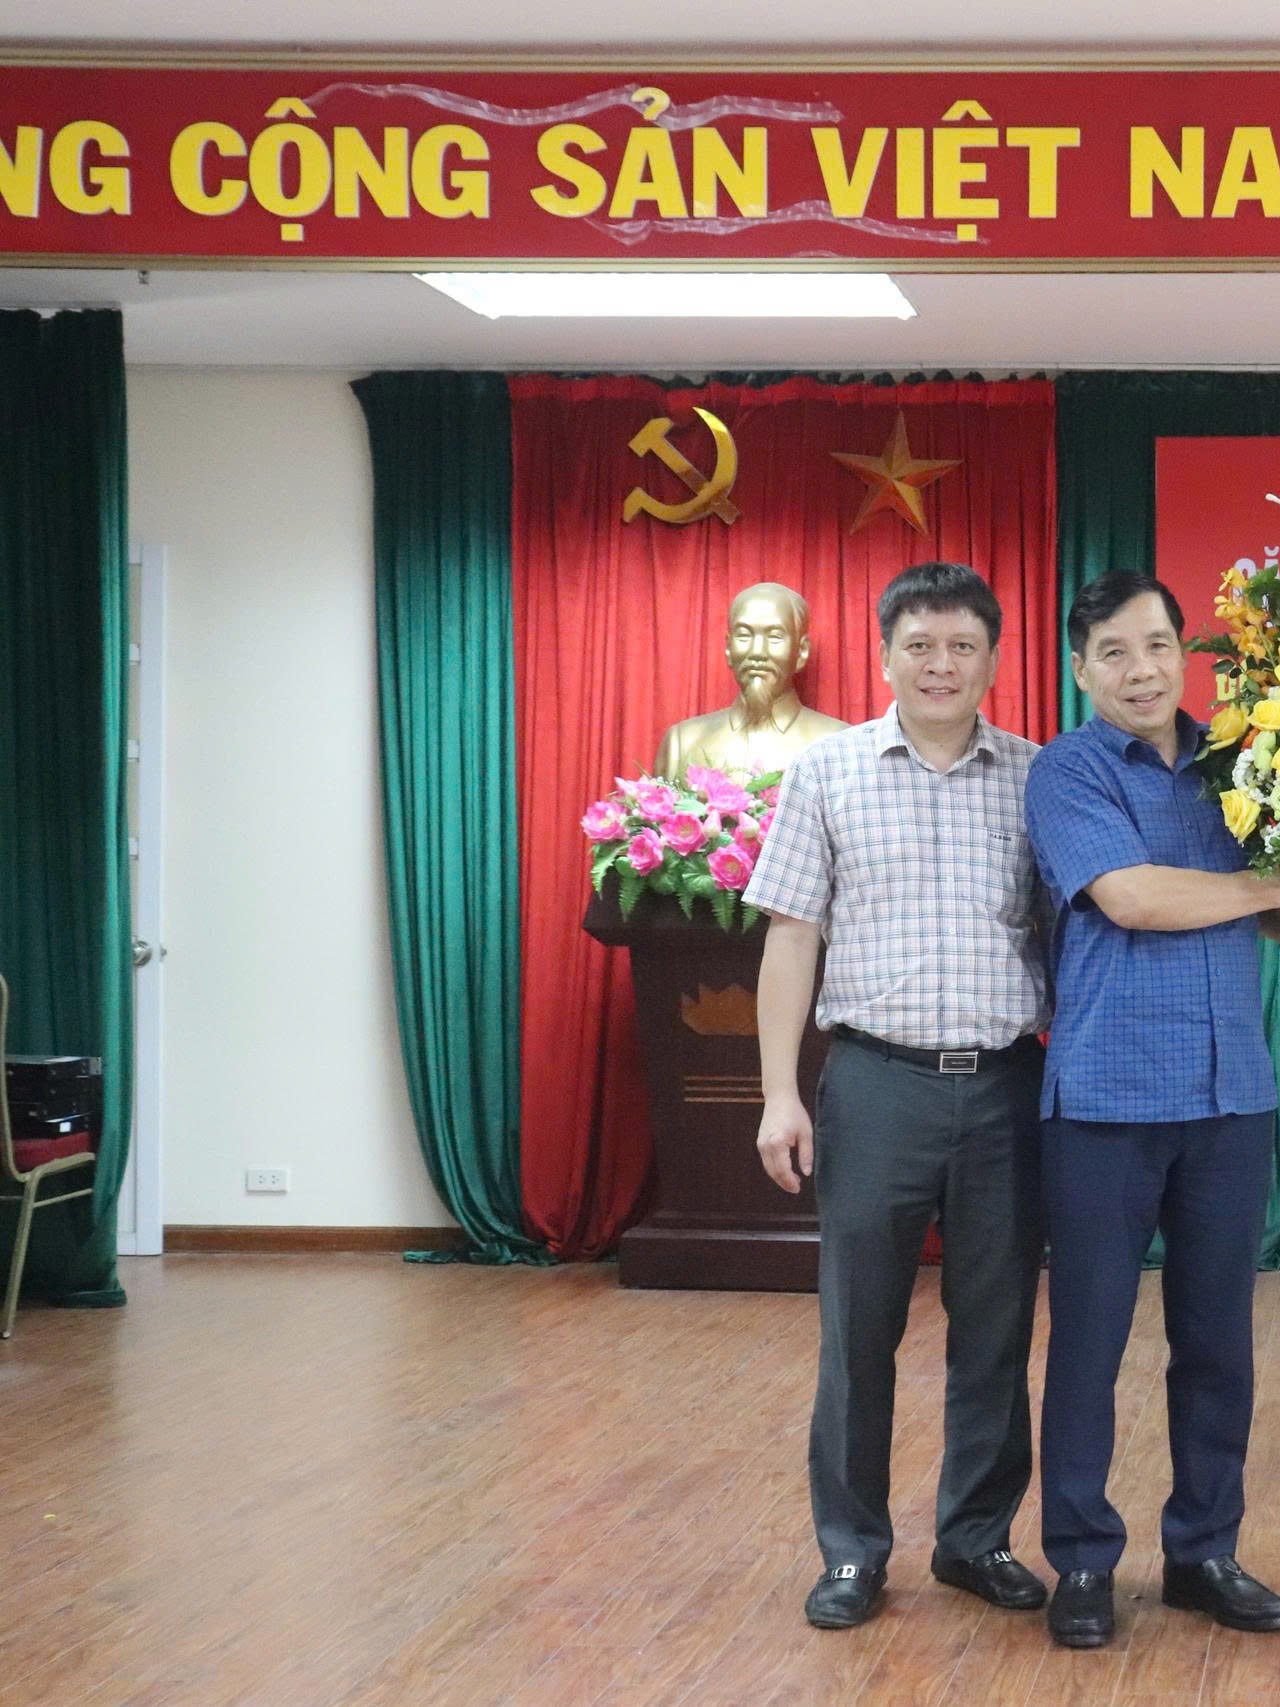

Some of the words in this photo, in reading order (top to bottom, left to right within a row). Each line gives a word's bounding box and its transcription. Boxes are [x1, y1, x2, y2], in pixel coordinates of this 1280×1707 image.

[170, 97, 489, 242] CỘNG
[530, 87, 767, 219] SẢN
[811, 100, 1080, 242] VIỆT
